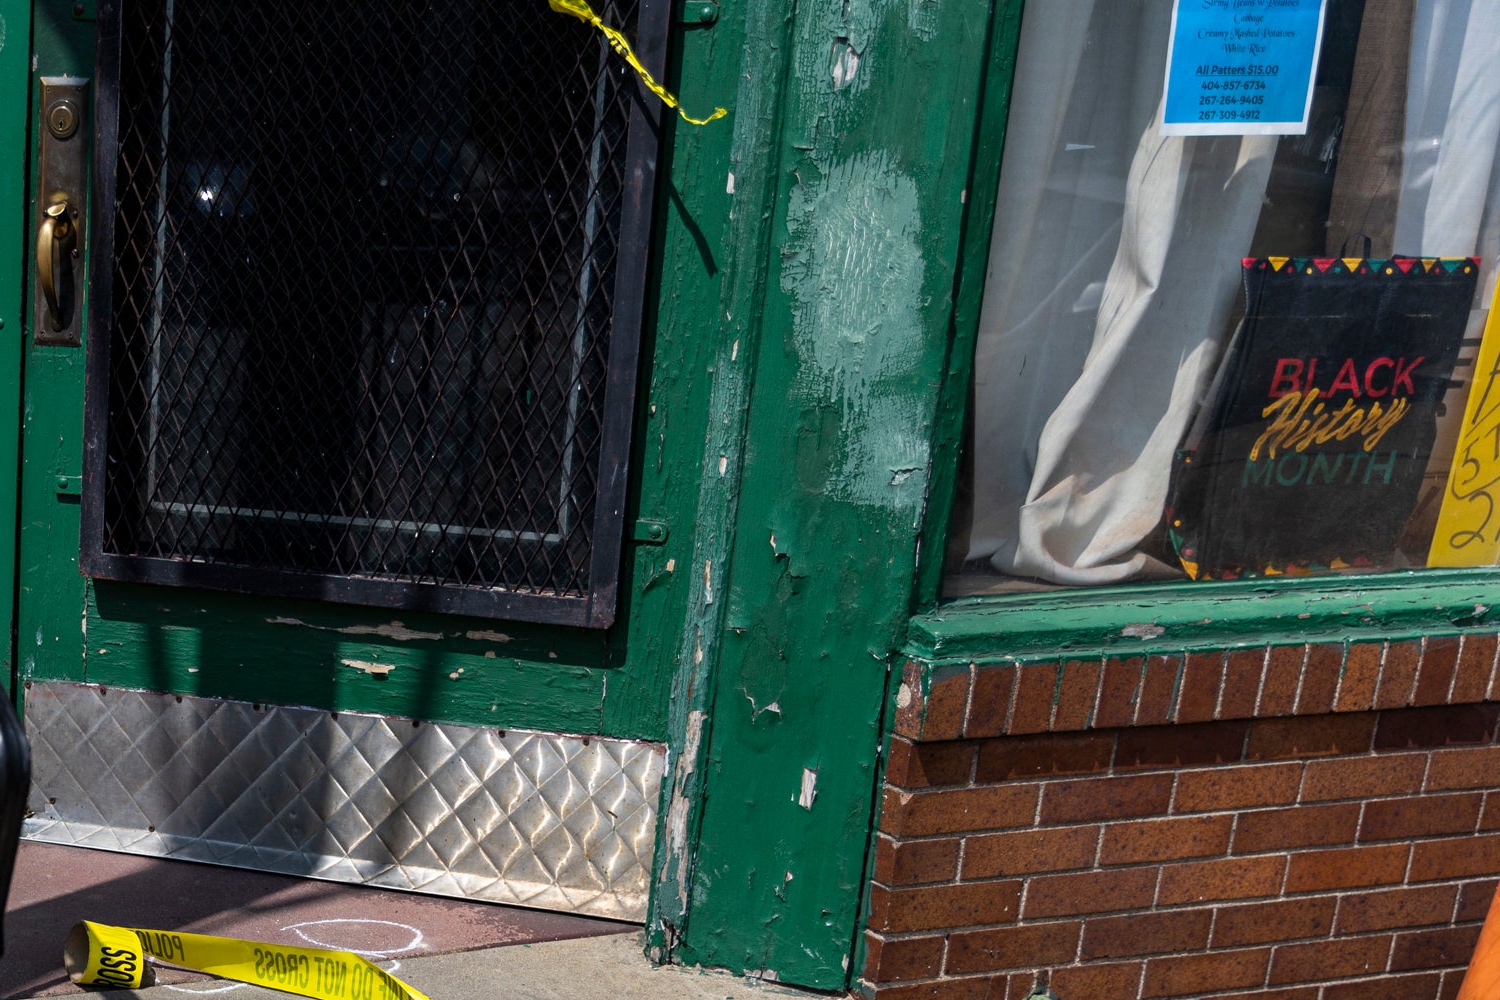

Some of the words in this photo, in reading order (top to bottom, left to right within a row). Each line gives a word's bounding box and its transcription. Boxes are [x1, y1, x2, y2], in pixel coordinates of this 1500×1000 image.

[1197, 28, 1229, 40] Creamy
[1262, 28, 1295, 38] Potatoes
[1223, 43, 1246, 53] White
[1248, 43, 1267, 56] Rice
[1196, 65, 1209, 75] All
[1211, 66, 1246, 75] Patters
[1248, 65, 1279, 75] $15.00
[1201, 81, 1266, 91] 404-857-6734
[1199, 95, 1264, 105] 267-264-9405
[1199, 110, 1260, 120] 267-309-4912
[1268, 356, 1424, 398] BLACK
[1250, 388, 1411, 461] History
[1242, 449, 1398, 488] MONTH
